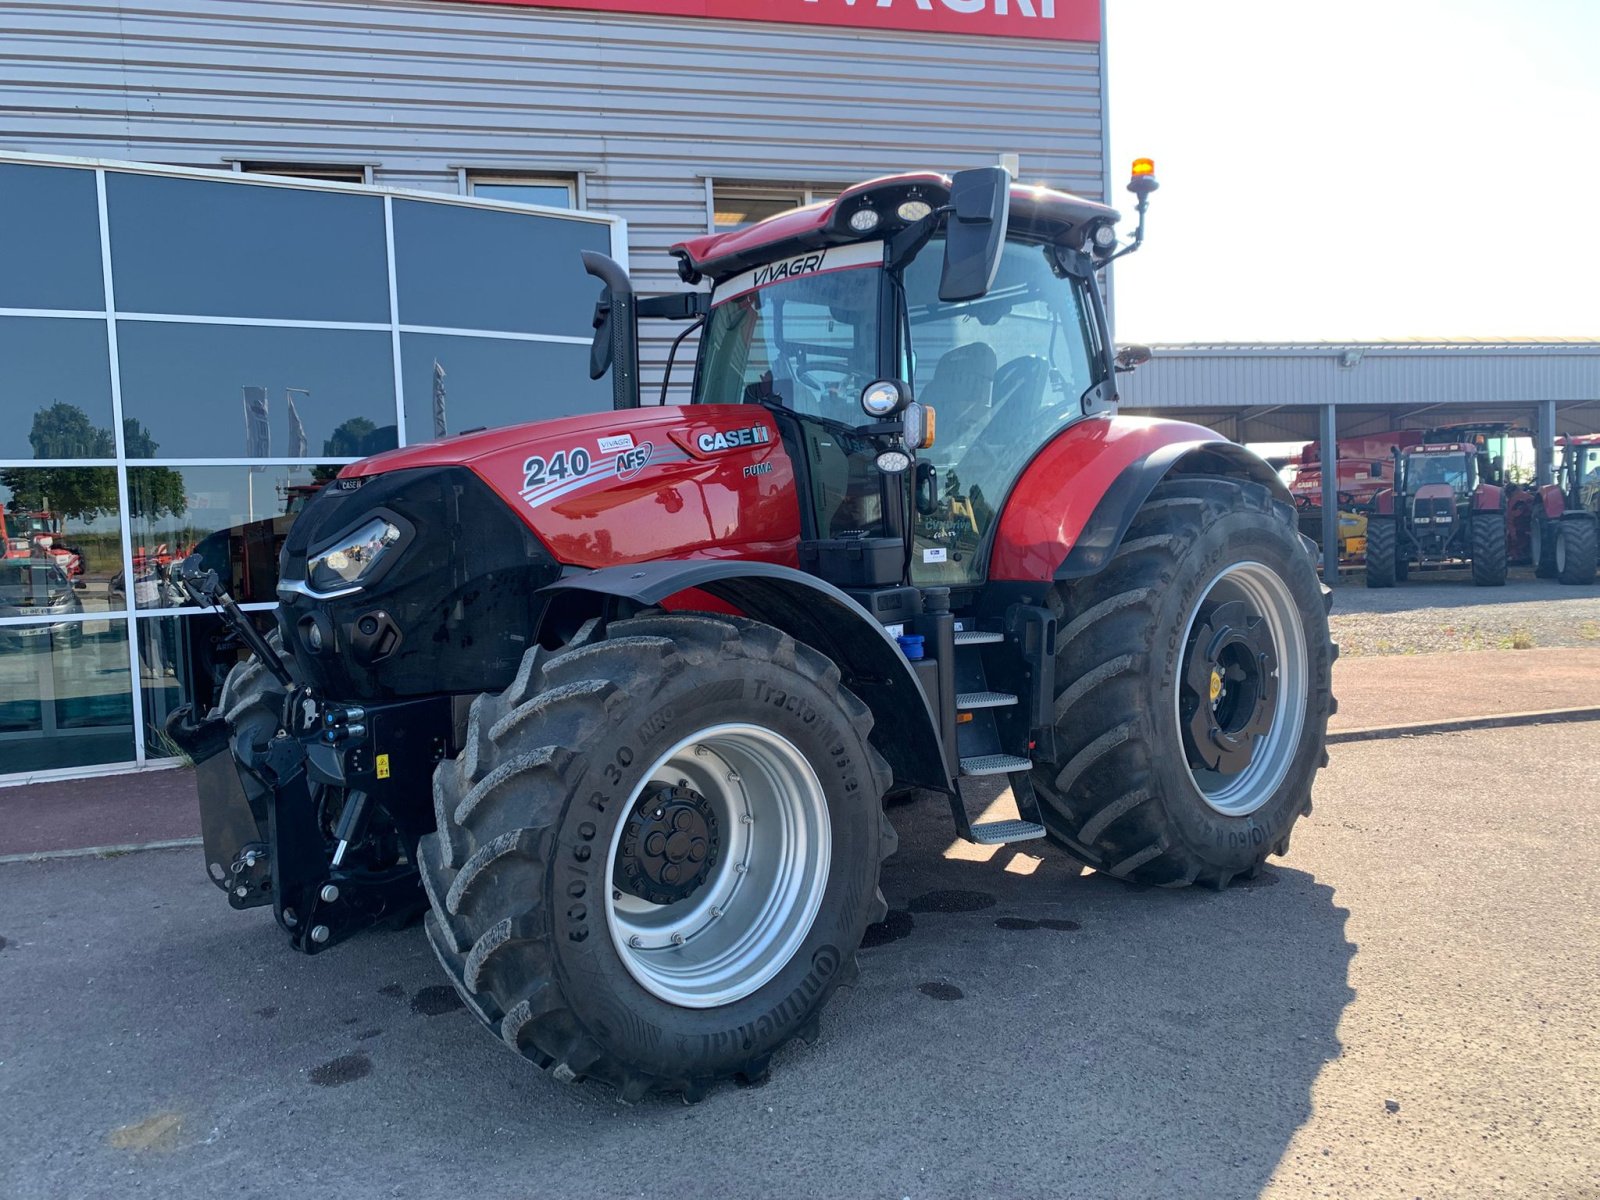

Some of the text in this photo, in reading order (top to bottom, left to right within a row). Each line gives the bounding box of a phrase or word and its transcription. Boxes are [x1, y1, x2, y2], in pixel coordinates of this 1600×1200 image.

[753, 250, 827, 287] VIVAGRI
[698, 428, 752, 452] CASE
[523, 447, 591, 489] 240
[616, 449, 646, 473] AFS
[743, 462, 773, 478] PUMA
[566, 822, 597, 943] 600/60
[589, 791, 610, 813] R
[604, 746, 634, 786] 30
[703, 944, 841, 1050] Continental
